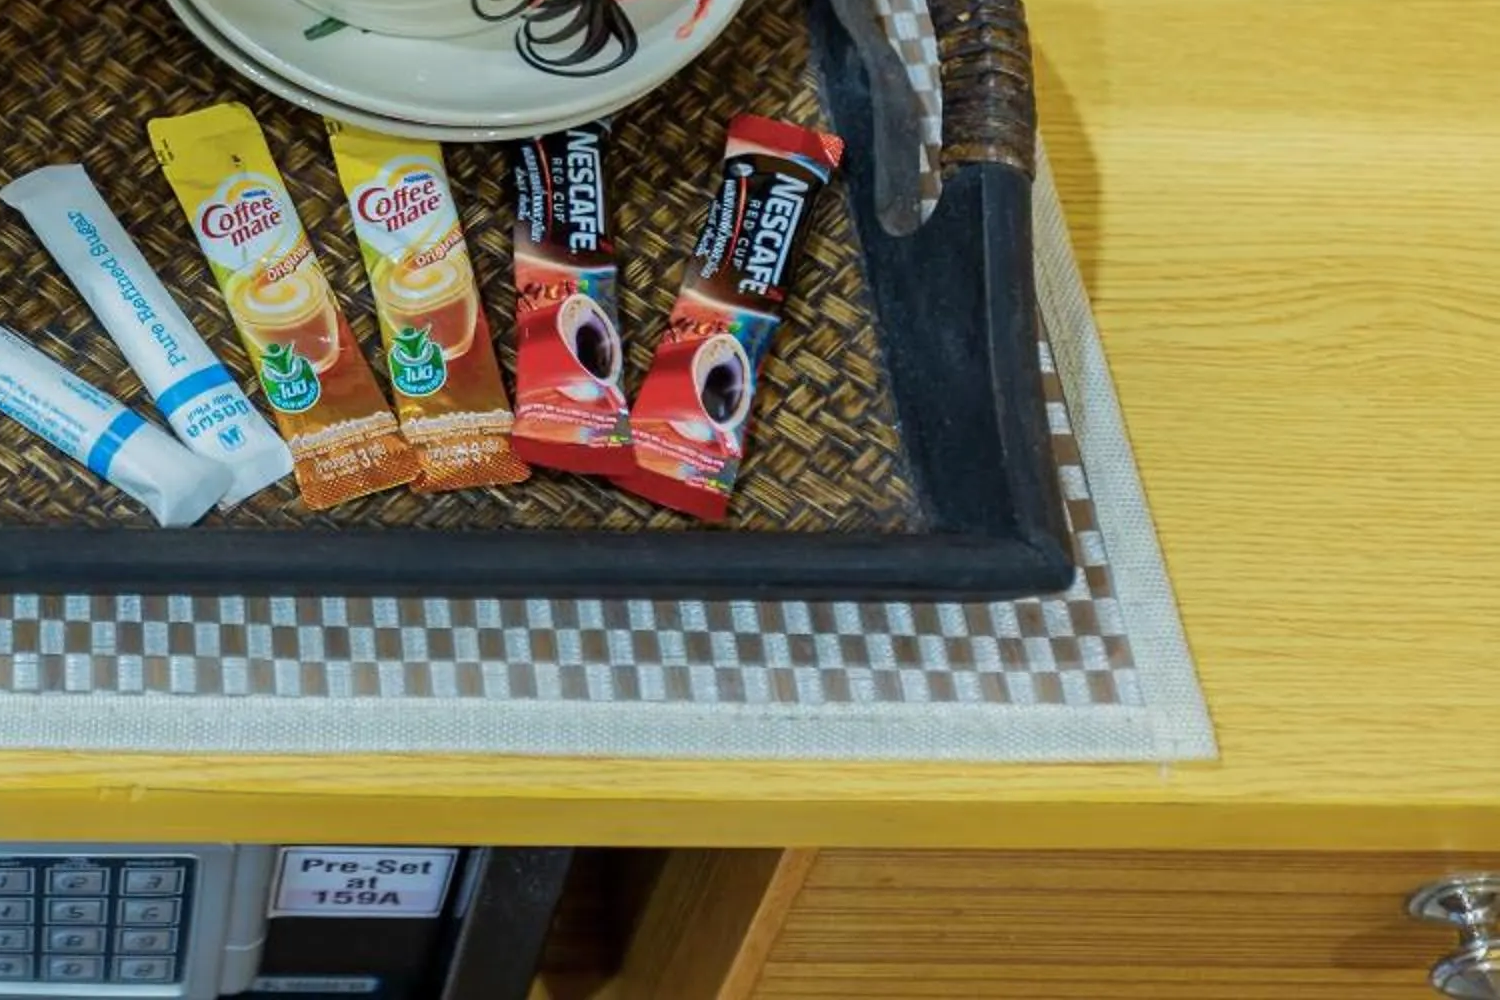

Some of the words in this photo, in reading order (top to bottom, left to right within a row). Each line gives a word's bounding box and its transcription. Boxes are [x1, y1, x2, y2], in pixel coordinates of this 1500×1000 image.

[202, 197, 274, 238] Coffee
[357, 179, 435, 222] Coffee
[386, 194, 439, 232] mate
[741, 198, 761, 231] RED
[64, 206, 109, 260] Sugar
[231, 211, 281, 247] mate
[730, 236, 749, 267] CUP
[98, 255, 157, 324] Refined
[143, 320, 188, 369] Pure
[302, 858, 433, 875] Pre-Set
[348, 876, 379, 889] at
[312, 890, 402, 906] 159A
